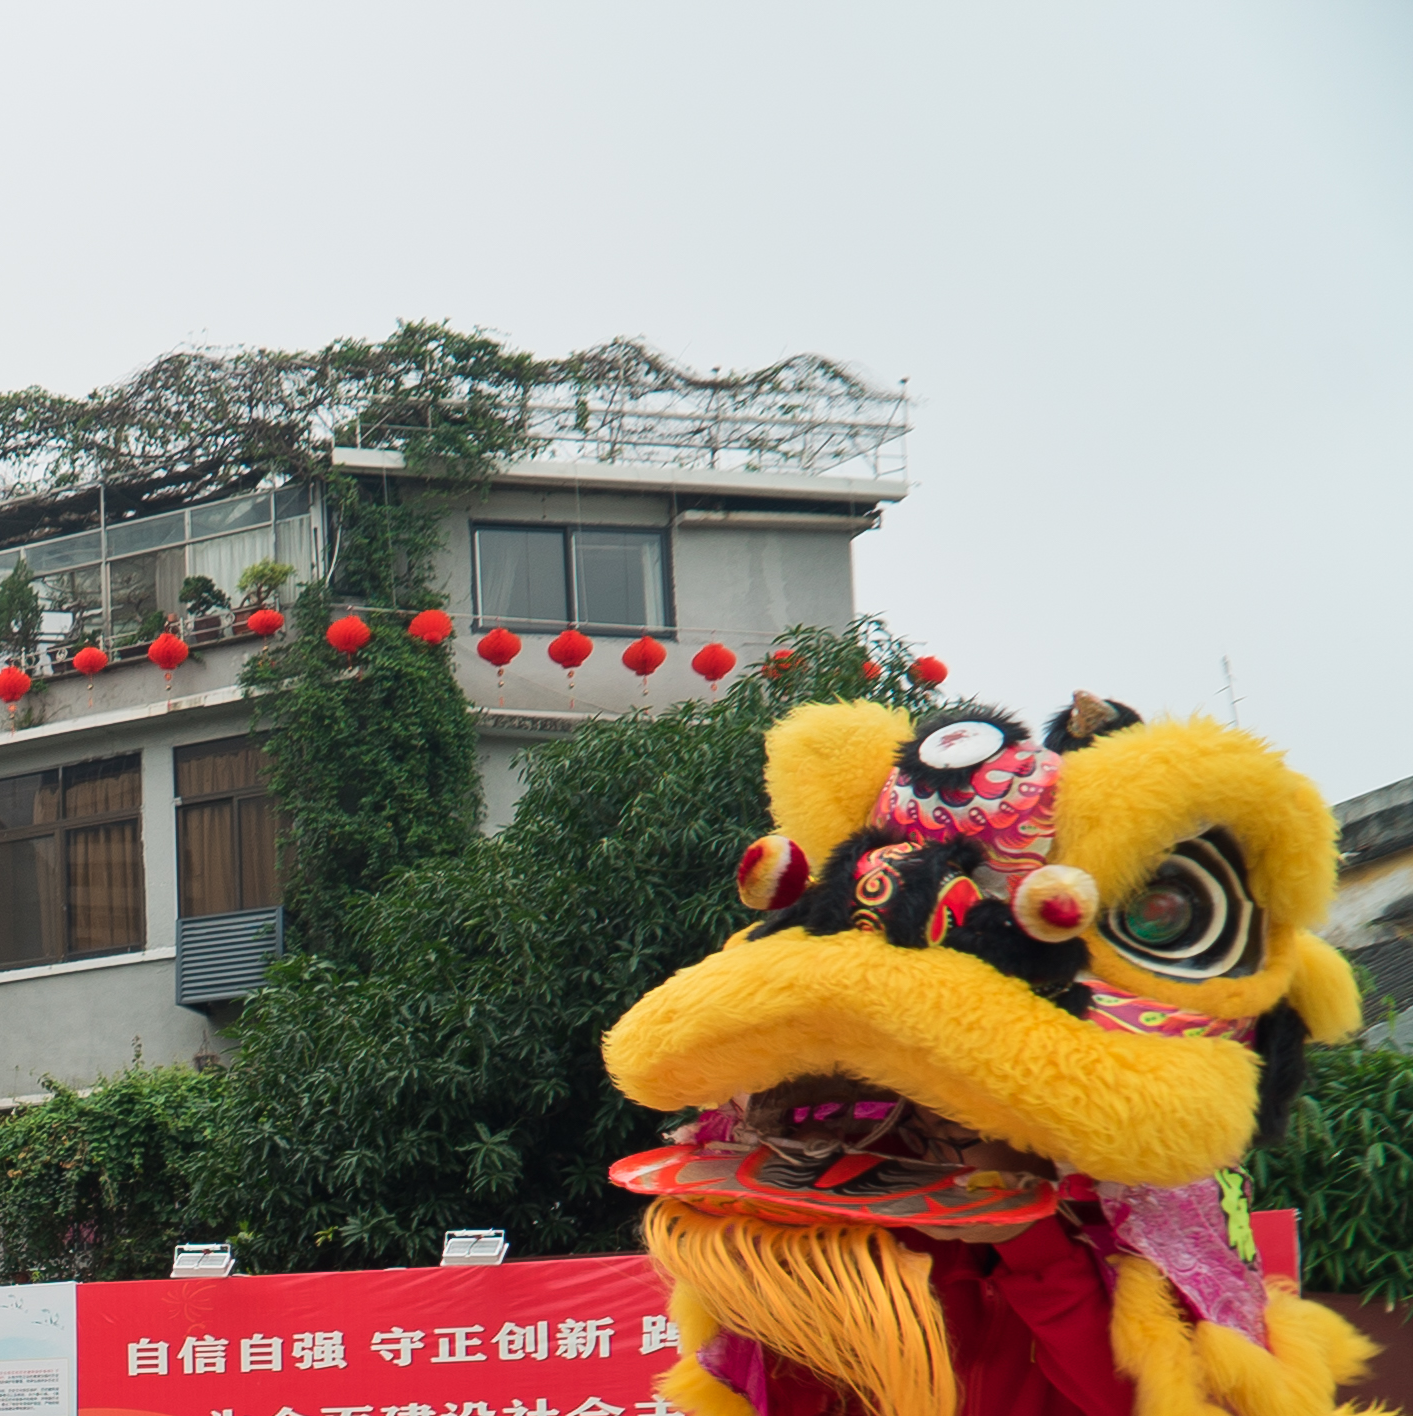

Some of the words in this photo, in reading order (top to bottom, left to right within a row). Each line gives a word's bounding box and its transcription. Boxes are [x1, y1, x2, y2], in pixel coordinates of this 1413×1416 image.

[127, 1331, 348, 1378] 自信自强
[371, 1316, 616, 1368] 守正创新
